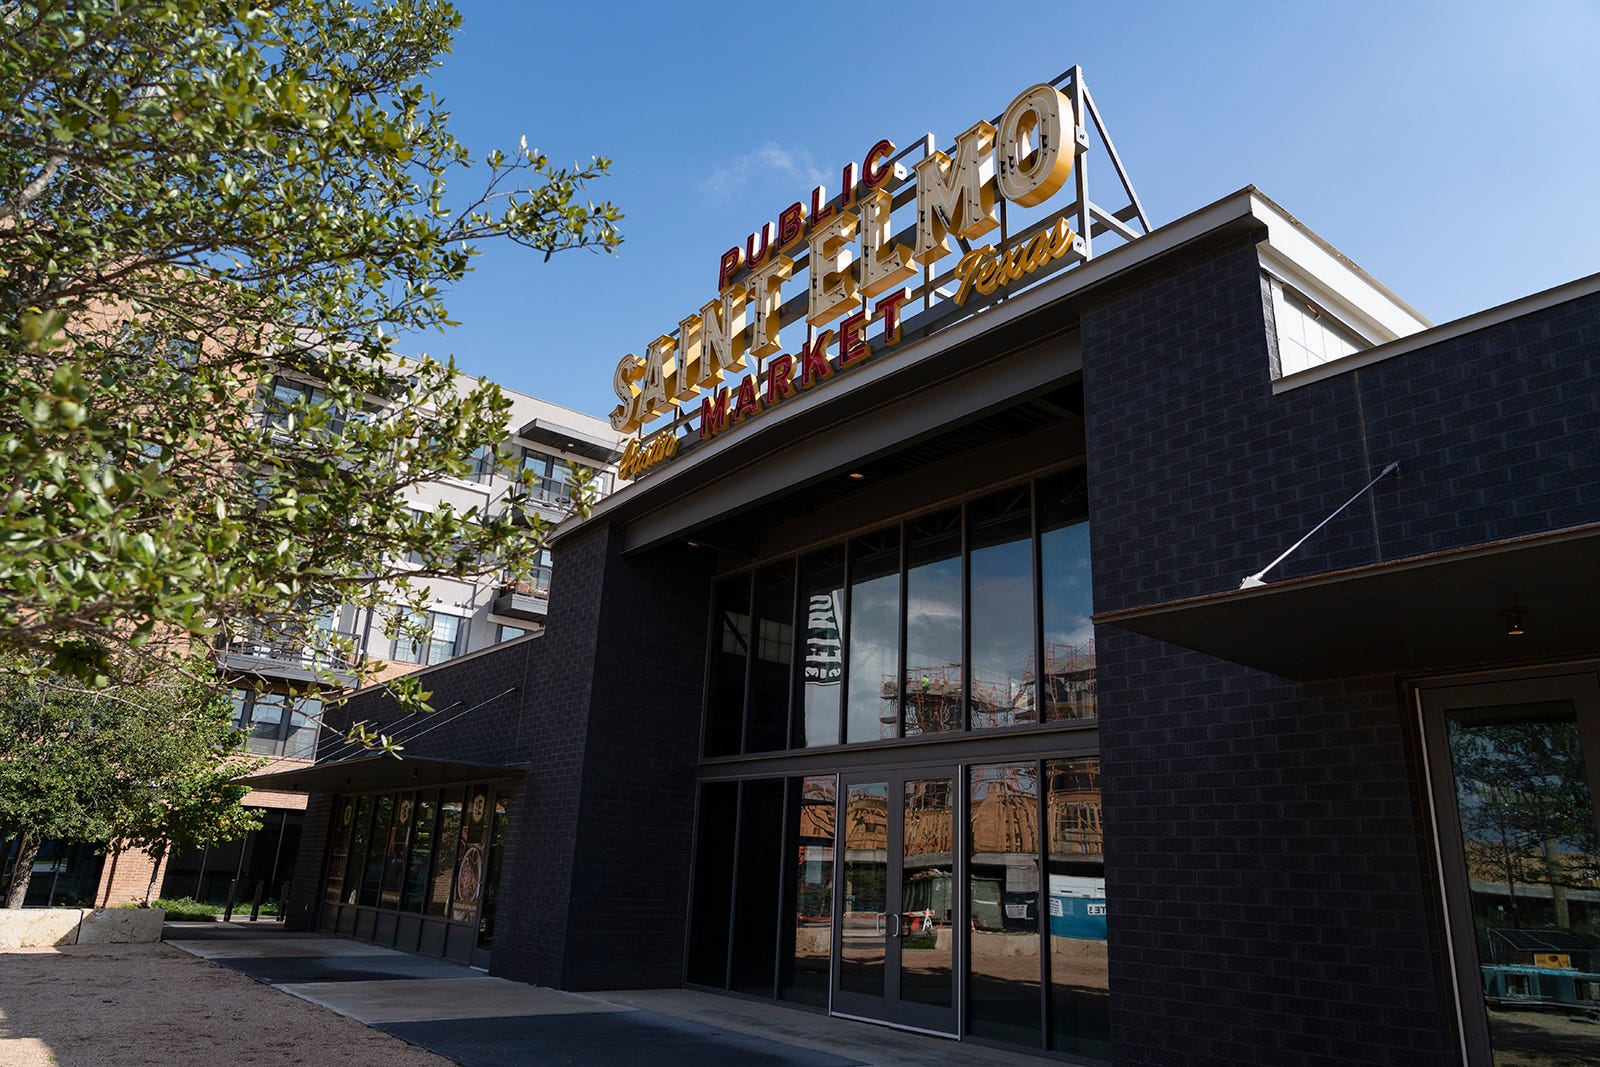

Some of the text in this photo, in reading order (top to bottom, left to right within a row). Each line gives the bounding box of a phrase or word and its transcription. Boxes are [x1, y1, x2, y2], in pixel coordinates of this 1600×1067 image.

[609, 83, 1075, 434] SAINT ELMO
[717, 139, 896, 291] PUBLIC
[953, 217, 1076, 306] Texas
[700, 287, 912, 440] MARKET
